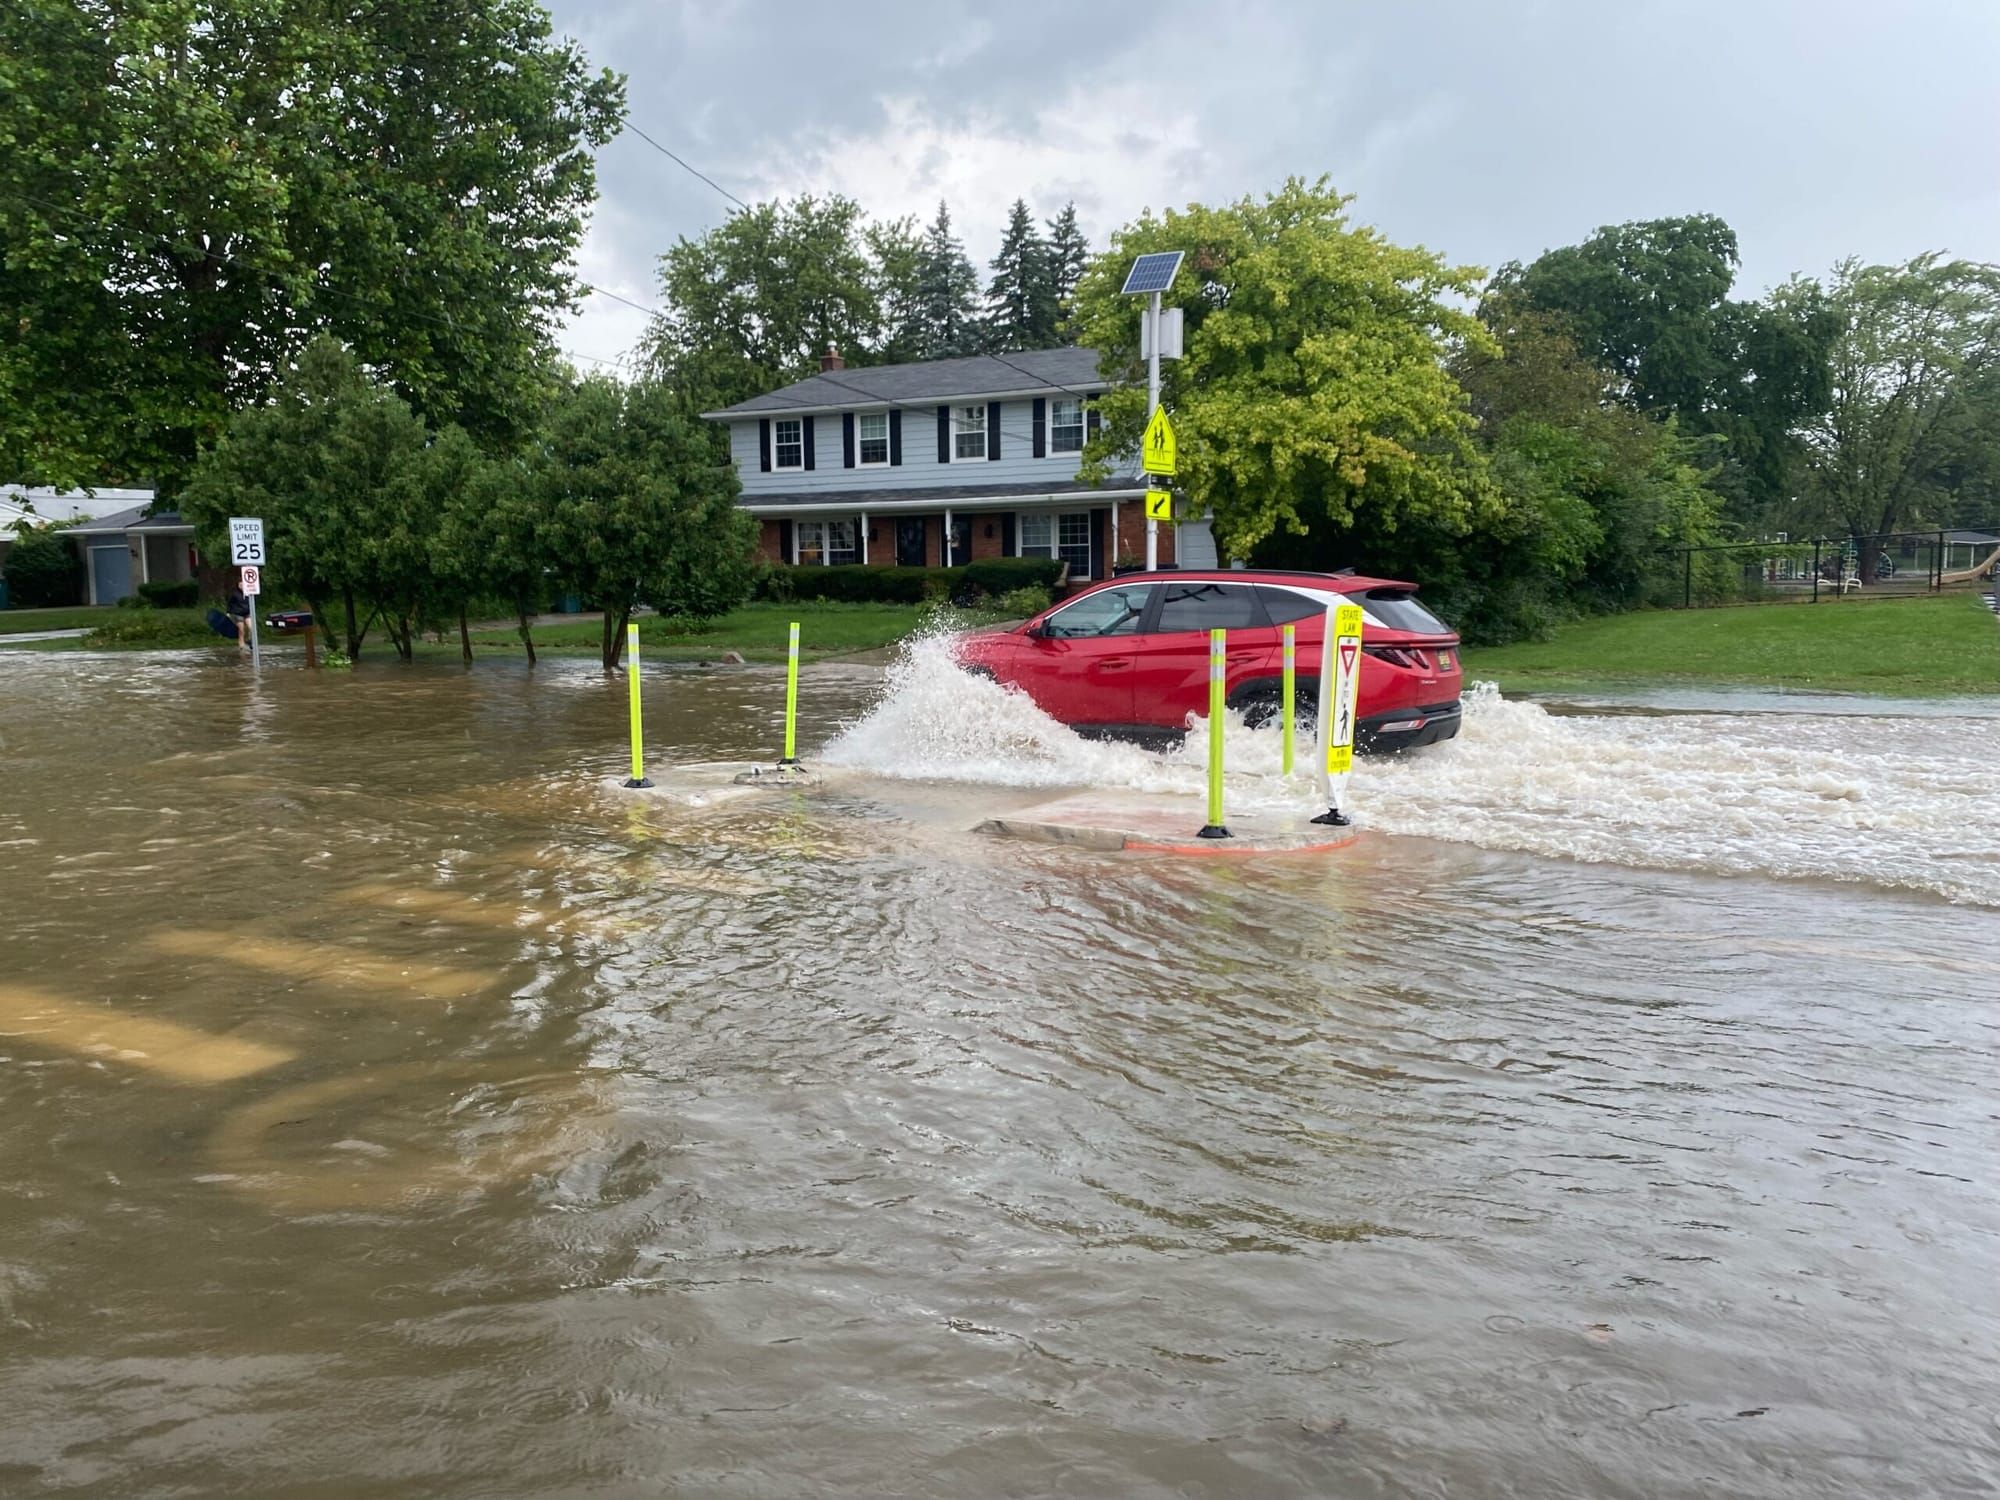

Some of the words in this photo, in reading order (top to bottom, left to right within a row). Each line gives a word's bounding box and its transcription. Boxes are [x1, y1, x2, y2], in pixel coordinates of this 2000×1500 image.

[237, 533, 257, 541] LIMIT
[236, 543, 261, 560] 25
[1342, 609, 1360, 621] STATE
